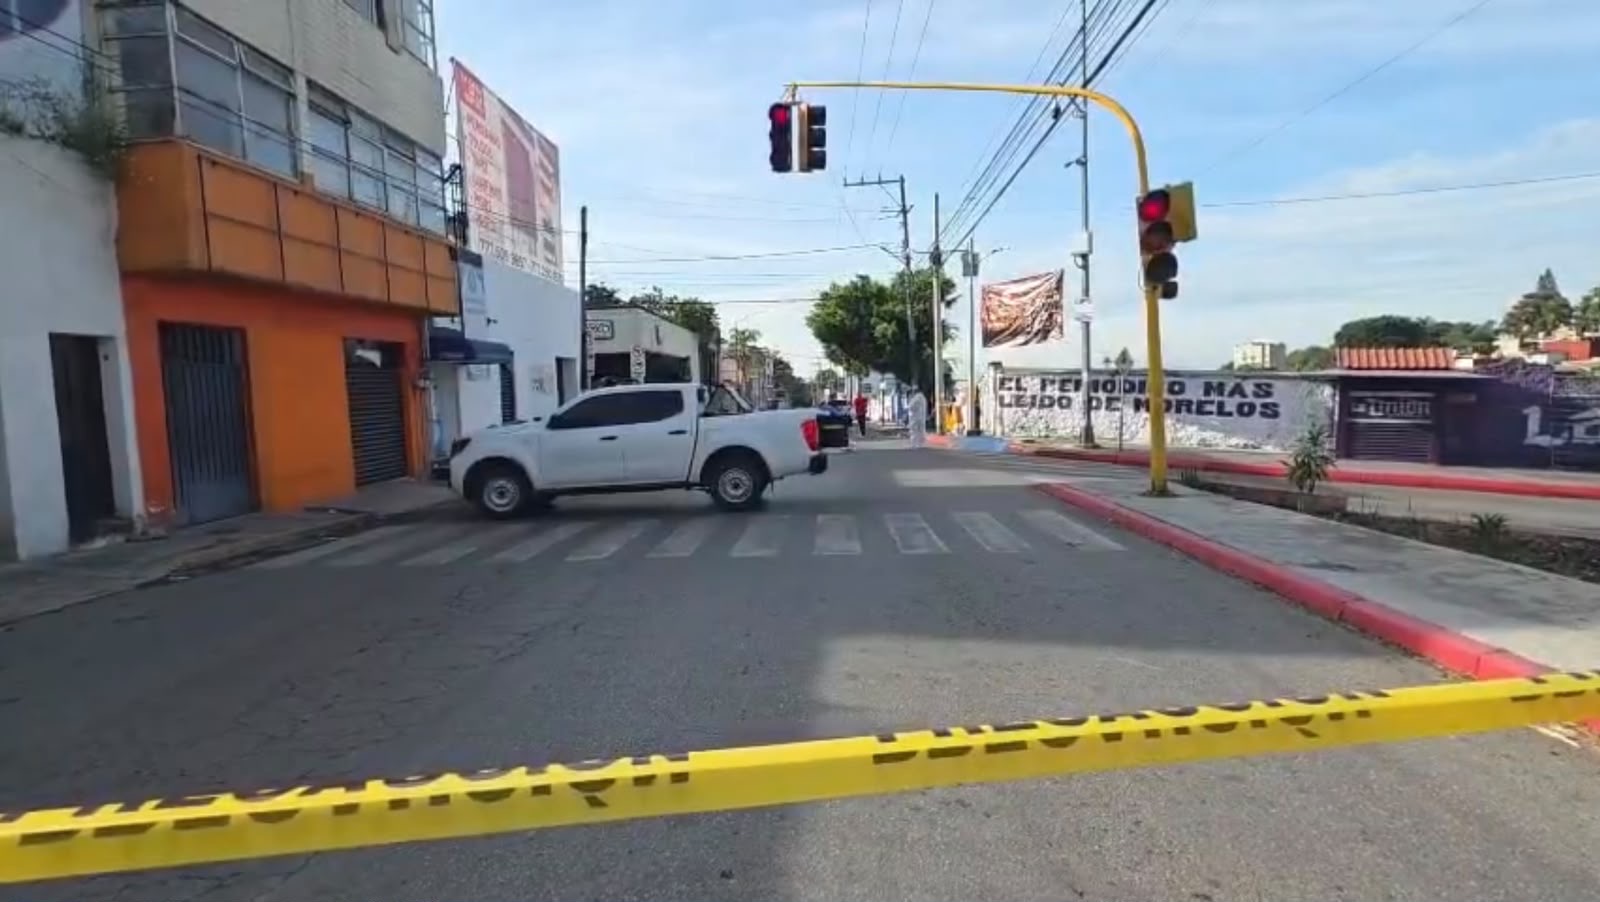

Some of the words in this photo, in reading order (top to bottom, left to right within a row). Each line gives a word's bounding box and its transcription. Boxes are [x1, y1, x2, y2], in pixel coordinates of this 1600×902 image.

[999, 376, 1028, 392] EL
[1040, 377, 1187, 395] PEIODIO
[1203, 380, 1275, 399] MAS
[998, 394, 1073, 410] LEIDO
[1087, 396, 1121, 412] DE
